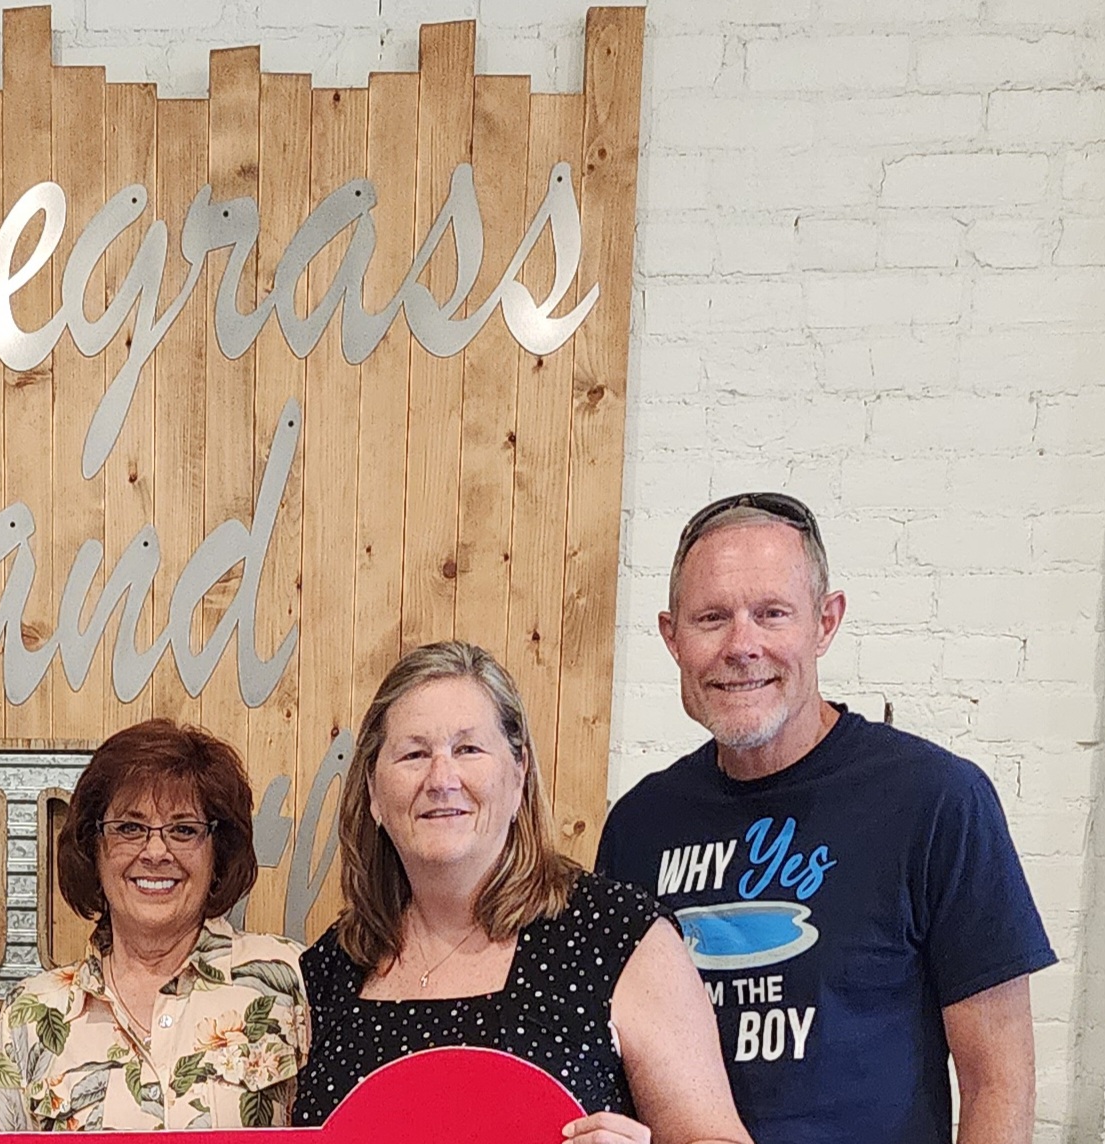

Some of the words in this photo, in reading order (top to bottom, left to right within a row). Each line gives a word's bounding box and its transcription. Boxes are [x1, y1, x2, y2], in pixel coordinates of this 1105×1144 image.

[657, 839, 738, 897] WHY
[738, 817, 838, 900] Yes
[732, 974, 784, 1005] THE
[734, 1006, 816, 1062] BOY
